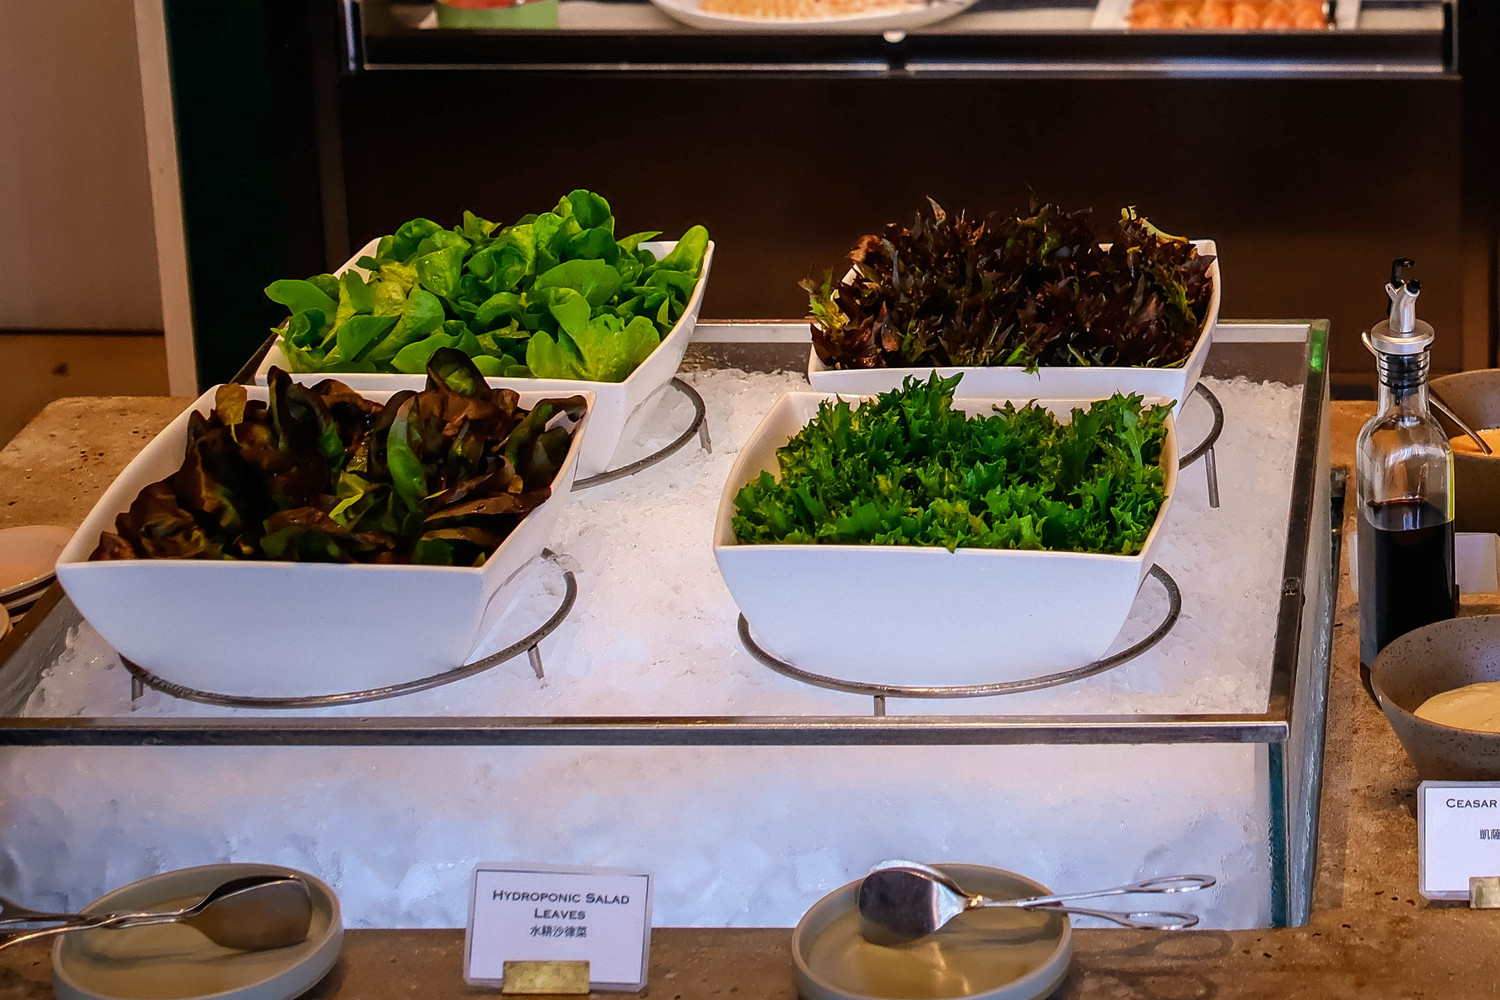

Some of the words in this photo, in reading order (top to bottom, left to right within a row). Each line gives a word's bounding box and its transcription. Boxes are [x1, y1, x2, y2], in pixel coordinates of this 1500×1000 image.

[1446, 798, 1498, 809] CEASAR
[493, 889, 581, 904] HYDROPONIC
[586, 893, 630, 905] SALAD
[534, 908, 586, 920] LEAVES
[530, 925, 588, 939] 水耕沙律菜
